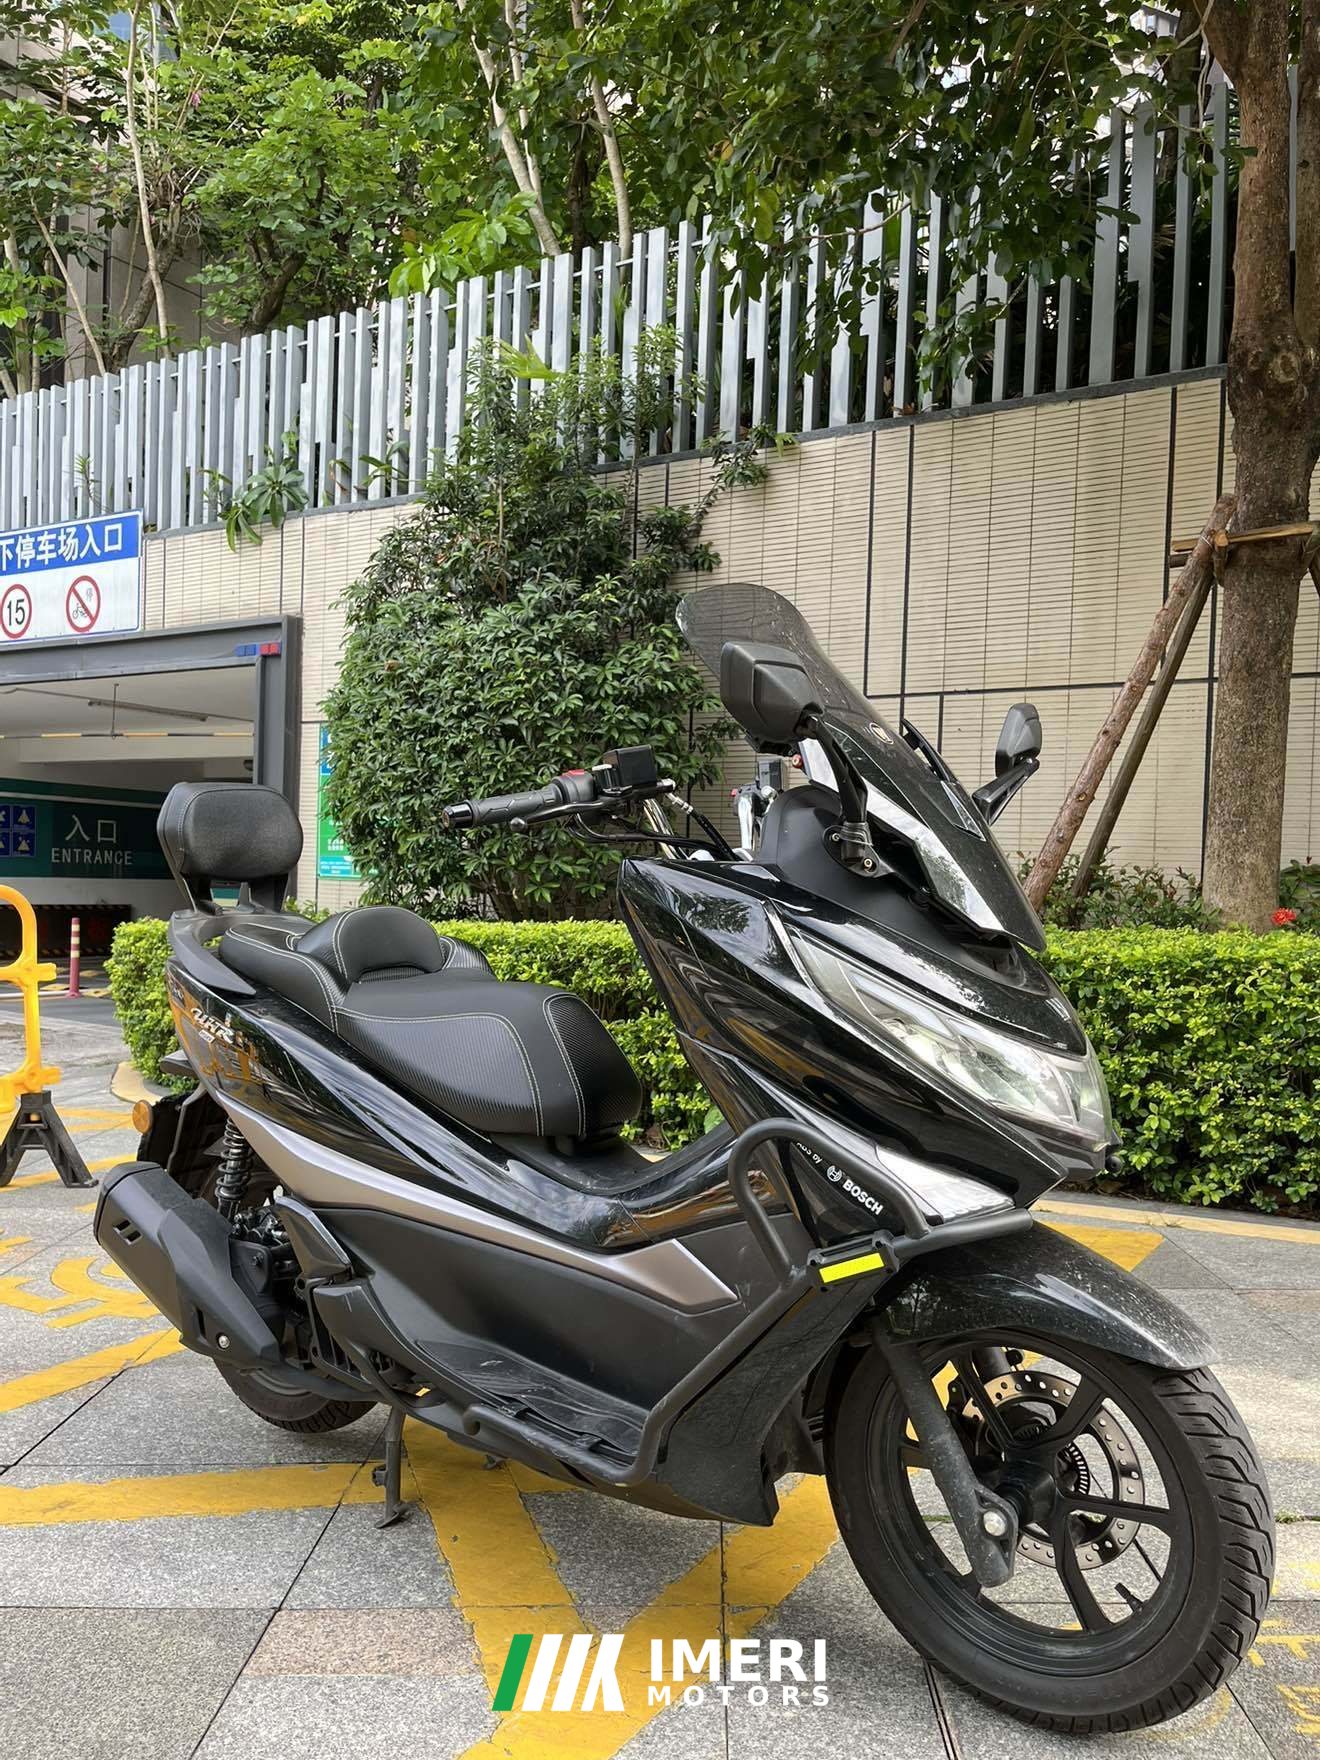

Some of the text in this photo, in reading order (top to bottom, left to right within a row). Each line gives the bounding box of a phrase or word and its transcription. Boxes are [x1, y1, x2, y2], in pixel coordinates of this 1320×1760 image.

[0, 523, 123, 571] 下停车场入口
[7, 598, 26, 627] 15
[65, 814, 117, 843] 入口
[51, 847, 133, 865] ENTRANCE
[842, 1178, 884, 1216] BOSCH
